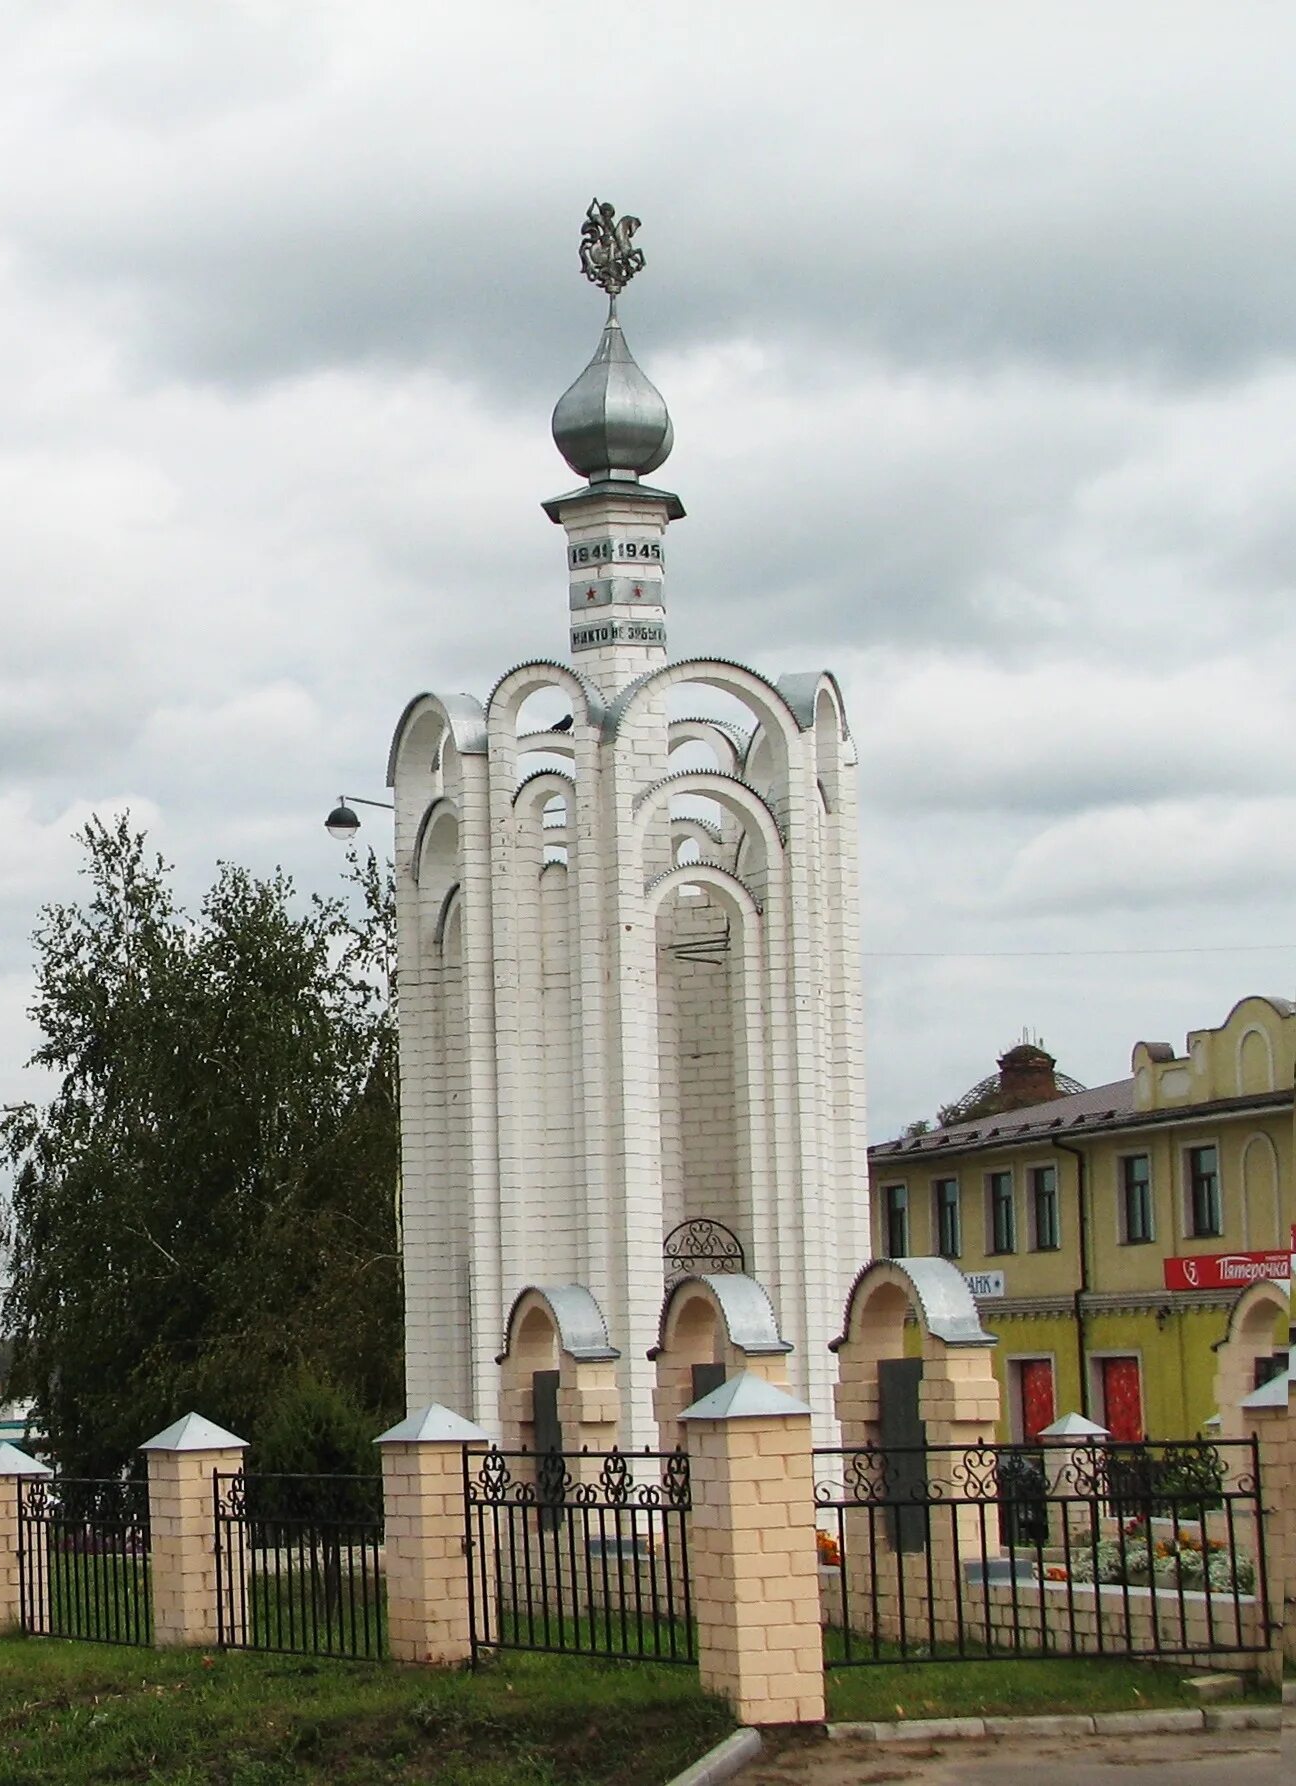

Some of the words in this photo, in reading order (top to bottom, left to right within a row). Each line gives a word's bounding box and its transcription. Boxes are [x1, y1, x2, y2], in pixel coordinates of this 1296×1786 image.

[573, 627, 608, 645] НИКТО
[611, 626, 624, 640] НЕ
[628, 627, 662, 641] ЗАБЫТ
[1215, 1256, 1288, 1281] Пятерочка
[965, 1275, 991, 1294] АНК
